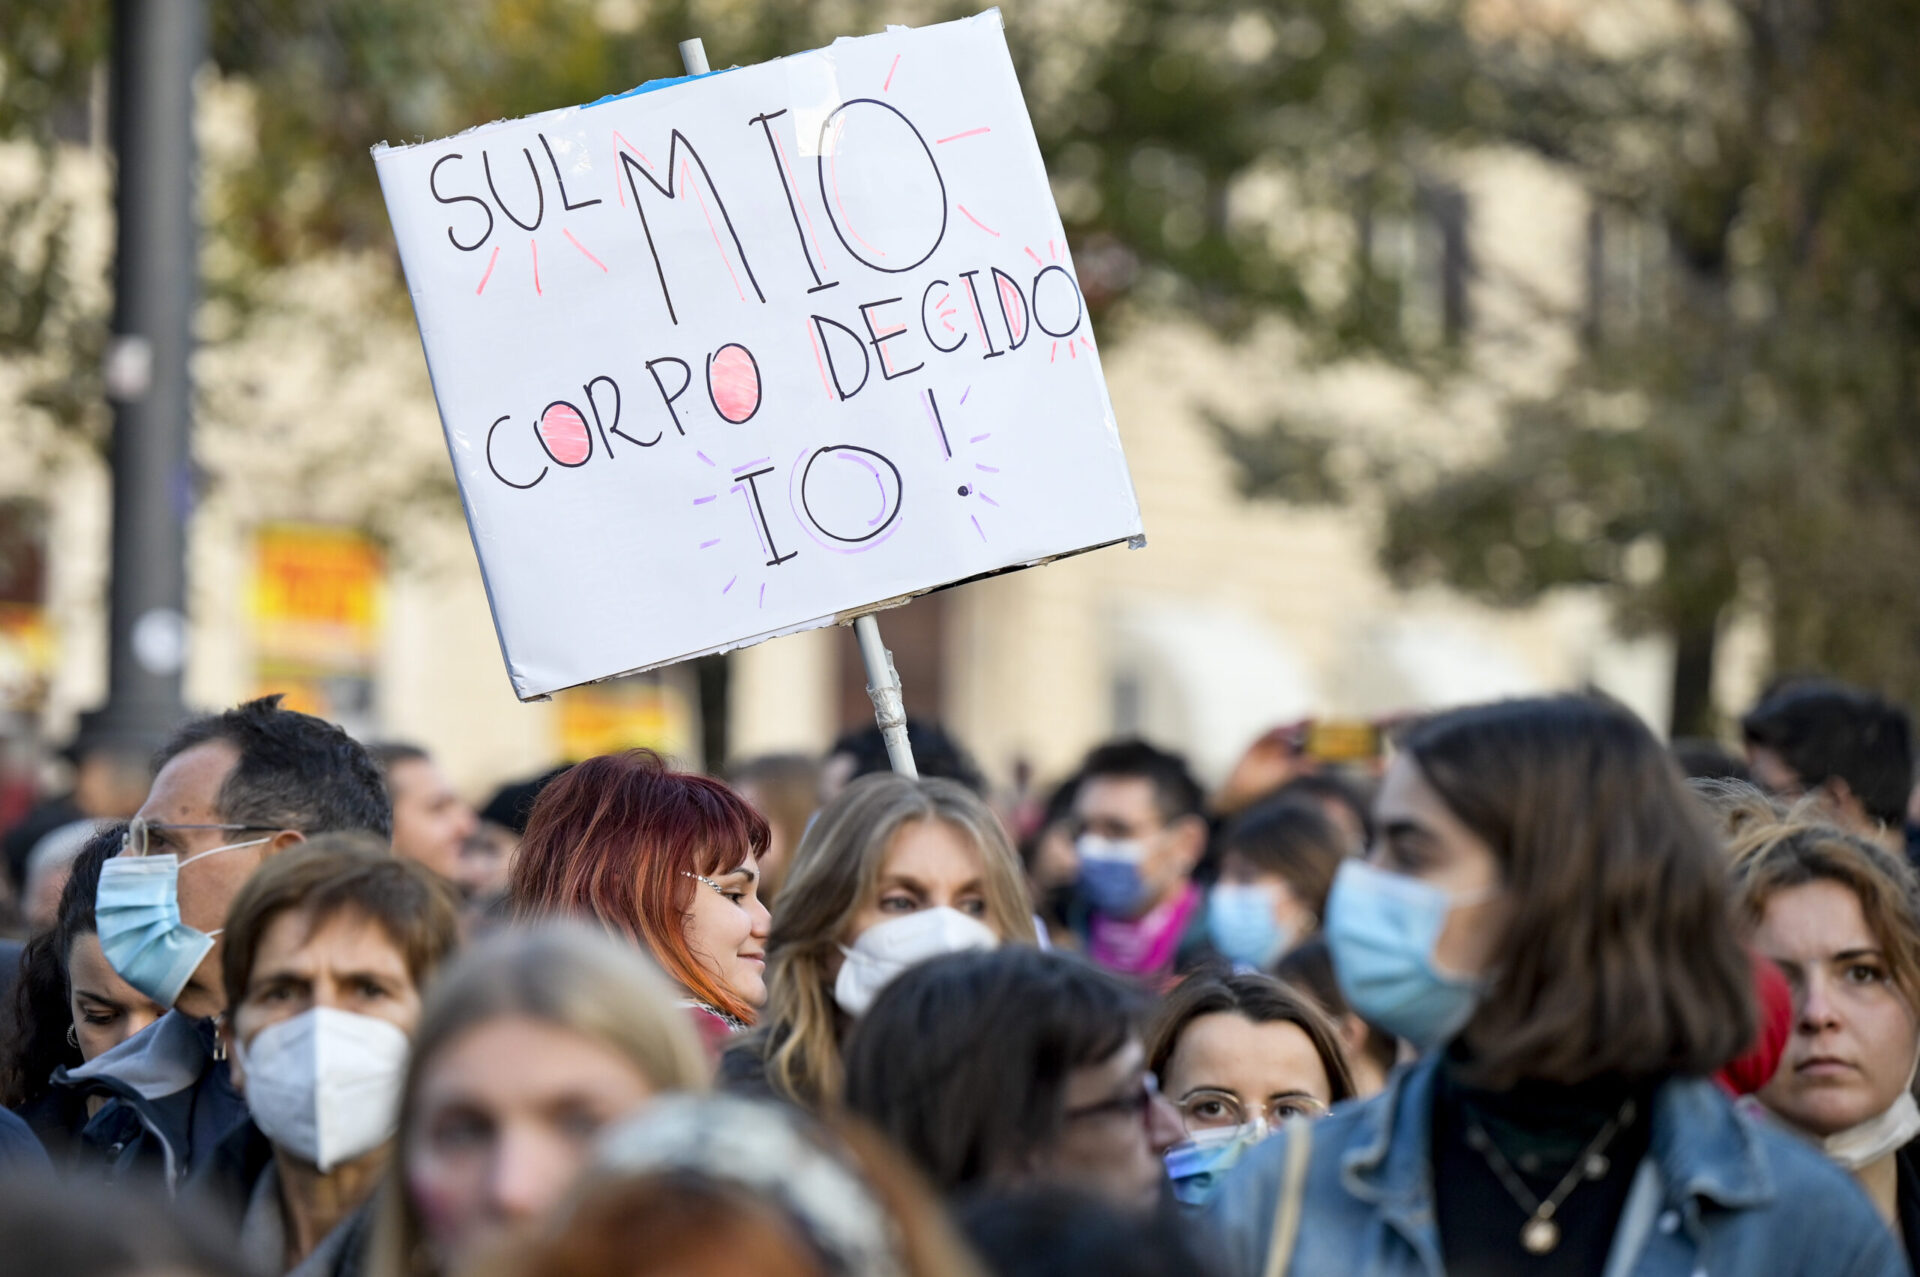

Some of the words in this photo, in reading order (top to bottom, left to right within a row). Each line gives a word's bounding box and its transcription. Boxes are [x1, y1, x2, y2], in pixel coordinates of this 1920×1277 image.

[430, 133, 602, 252] SUL
[619, 97, 948, 325] MIO
[486, 342, 762, 490] CORPO
[810, 265, 1083, 402] DECIDO
